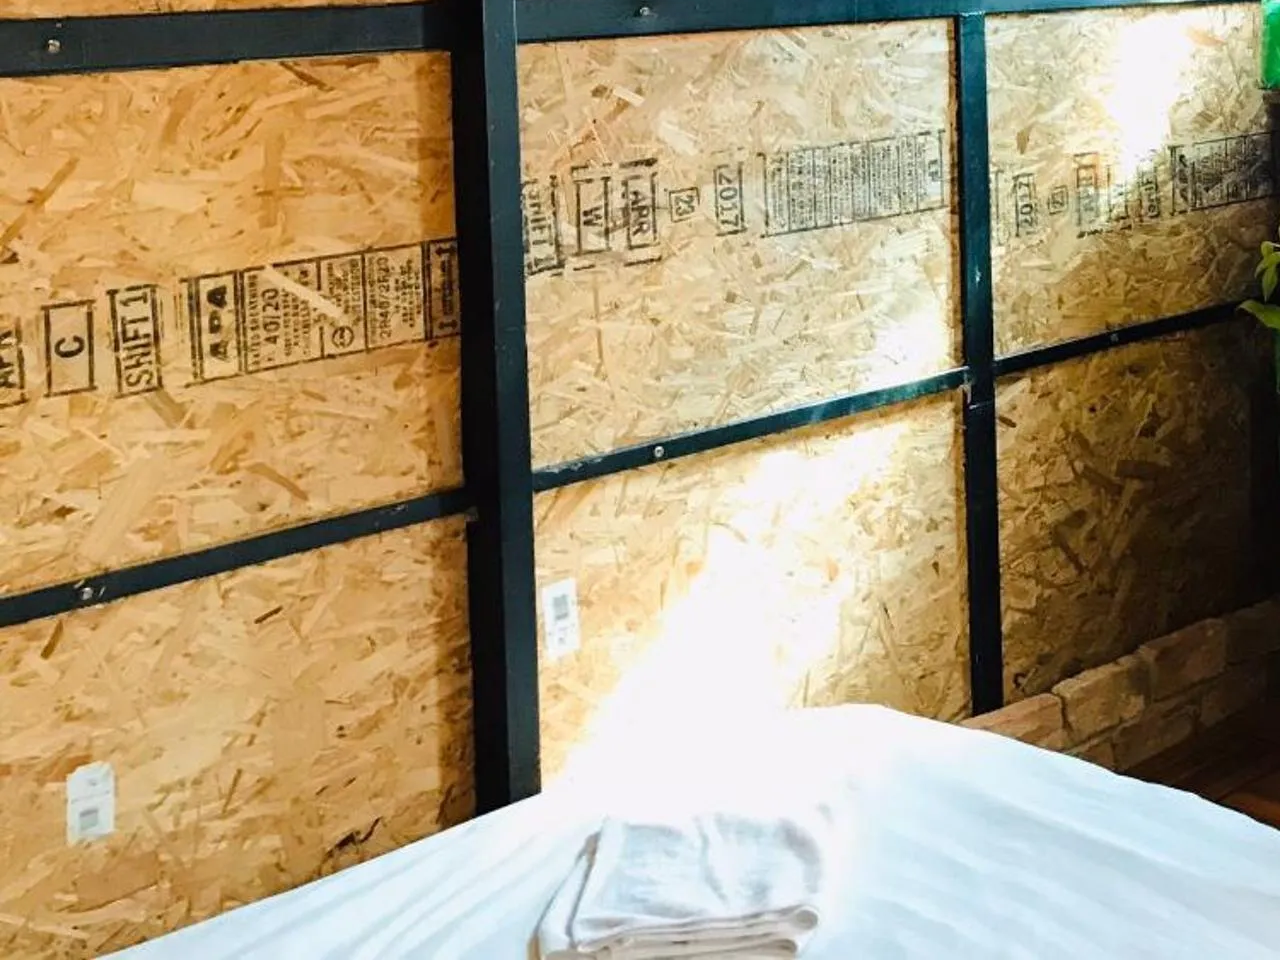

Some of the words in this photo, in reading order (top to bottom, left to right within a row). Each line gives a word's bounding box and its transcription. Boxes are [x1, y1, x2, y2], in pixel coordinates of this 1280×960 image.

[581, 206, 603, 228] W
[628, 189, 652, 236] APR
[674, 193, 694, 218] 23
[718, 171, 740, 227] 2017
[54, 335, 86, 359] C
[121, 315, 154, 388] SHIFT
